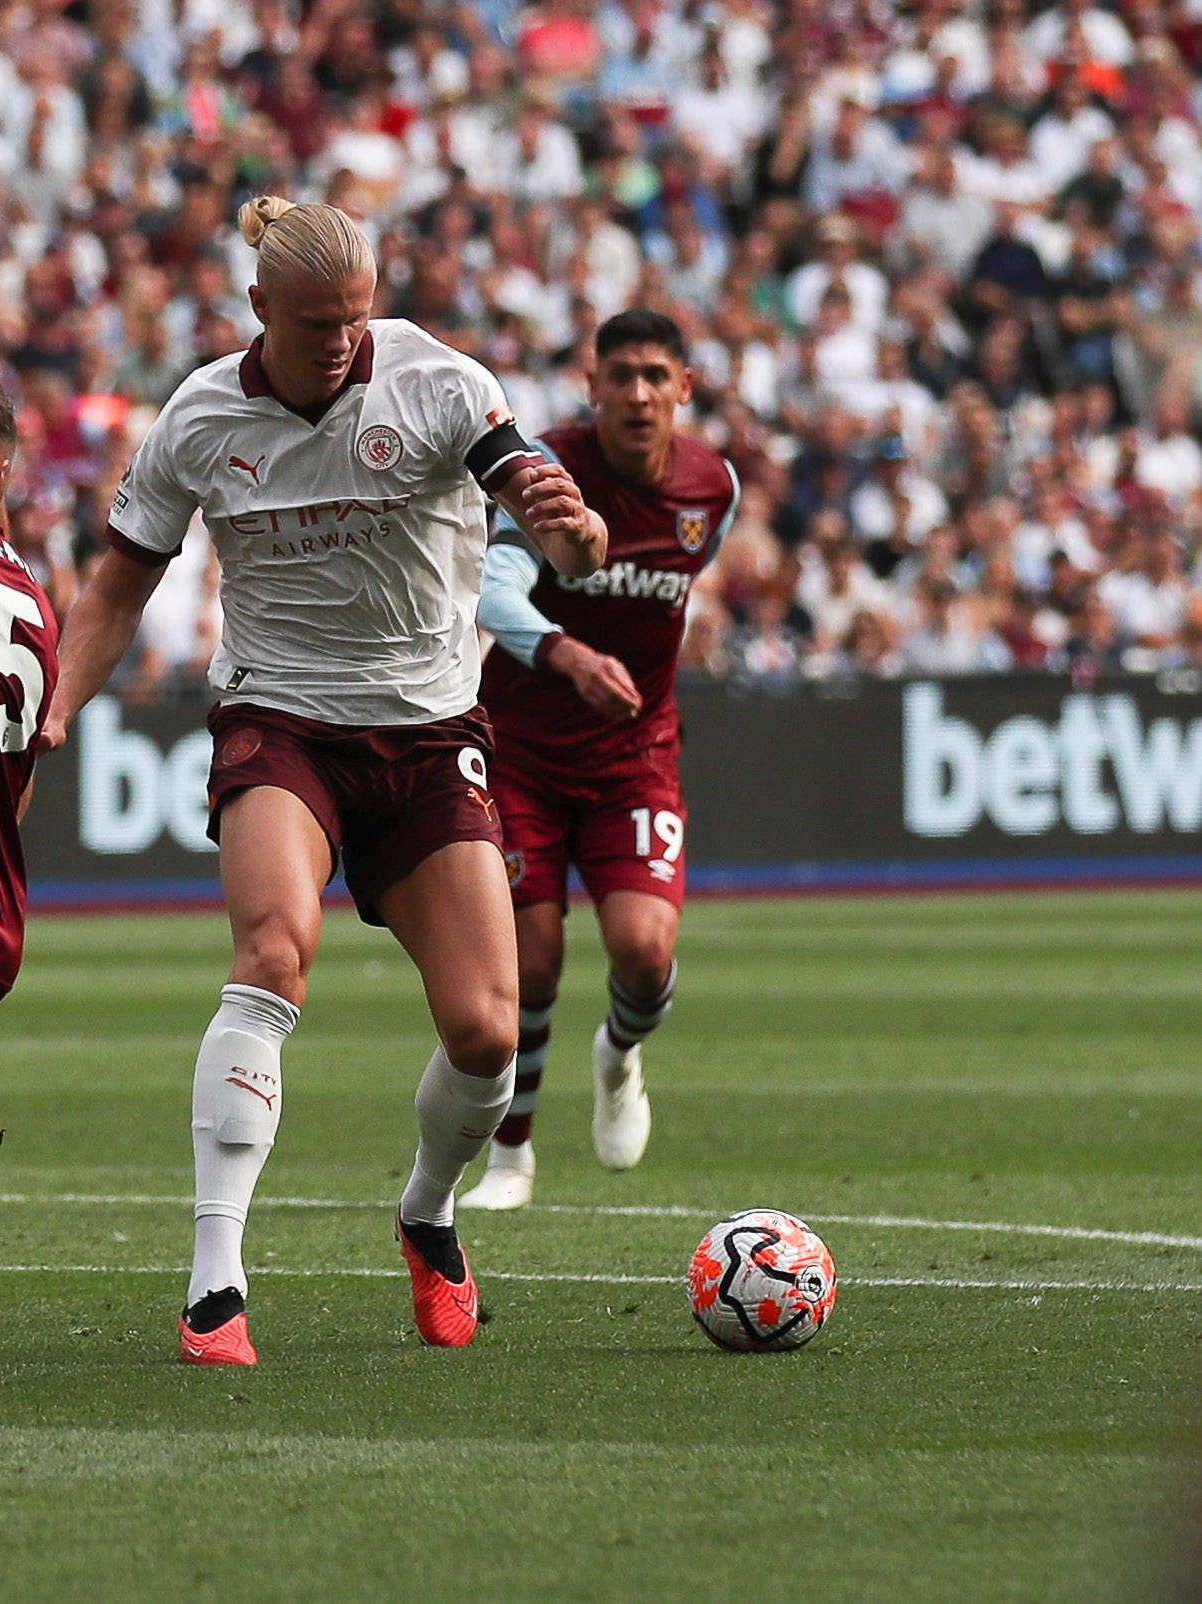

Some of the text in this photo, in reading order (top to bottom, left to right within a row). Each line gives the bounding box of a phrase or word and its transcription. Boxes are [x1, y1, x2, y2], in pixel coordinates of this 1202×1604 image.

[272, 522, 391, 557] AIRWAYS
[457, 746, 488, 791] 9
[630, 807, 684, 862] 19
[231, 1066, 277, 1086] CITY
